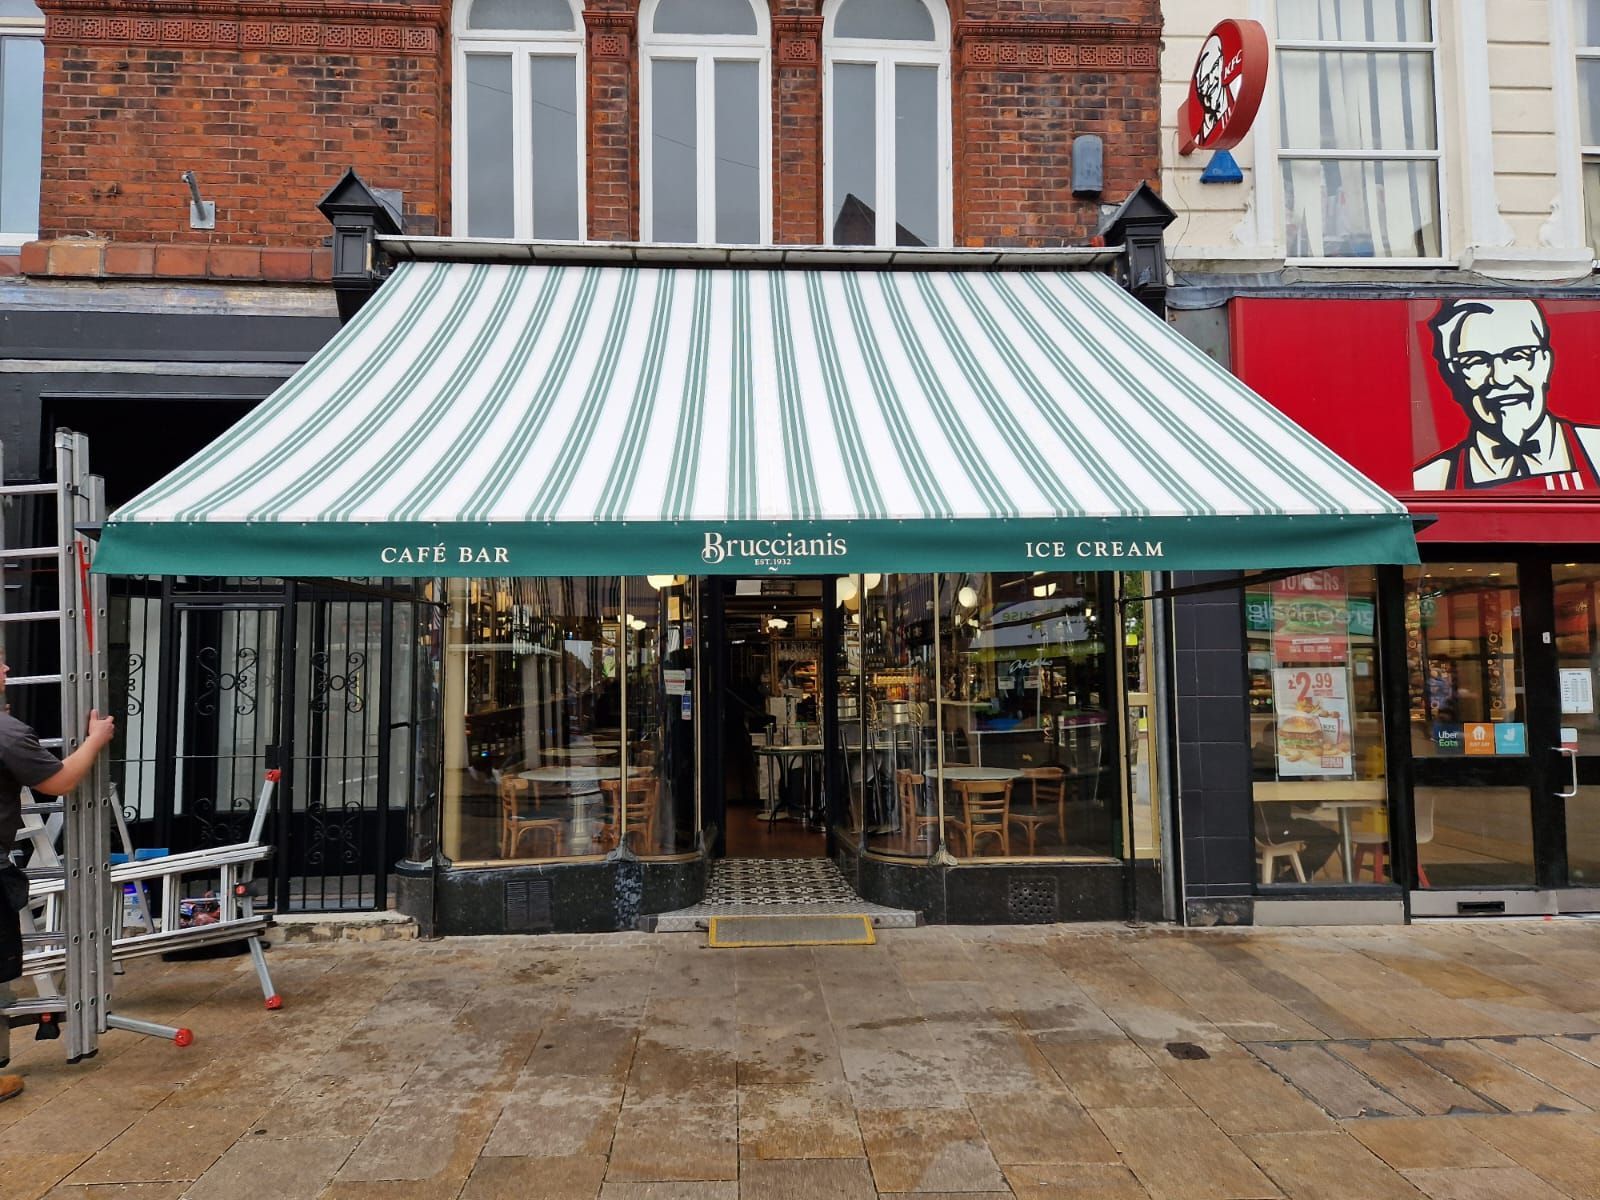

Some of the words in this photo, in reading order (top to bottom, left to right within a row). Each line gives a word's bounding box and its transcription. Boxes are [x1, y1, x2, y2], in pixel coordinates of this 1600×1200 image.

[1223, 49, 1243, 80] KFC
[381, 542, 447, 563] CAFÉ
[458, 546, 510, 563] BAR
[701, 532, 848, 564] Bruccianis
[1025, 542, 1066, 557] ICE
[1076, 541, 1165, 557] CREAM
[1438, 731, 1458, 739] Uber
[1439, 739, 1458, 747] Eats
